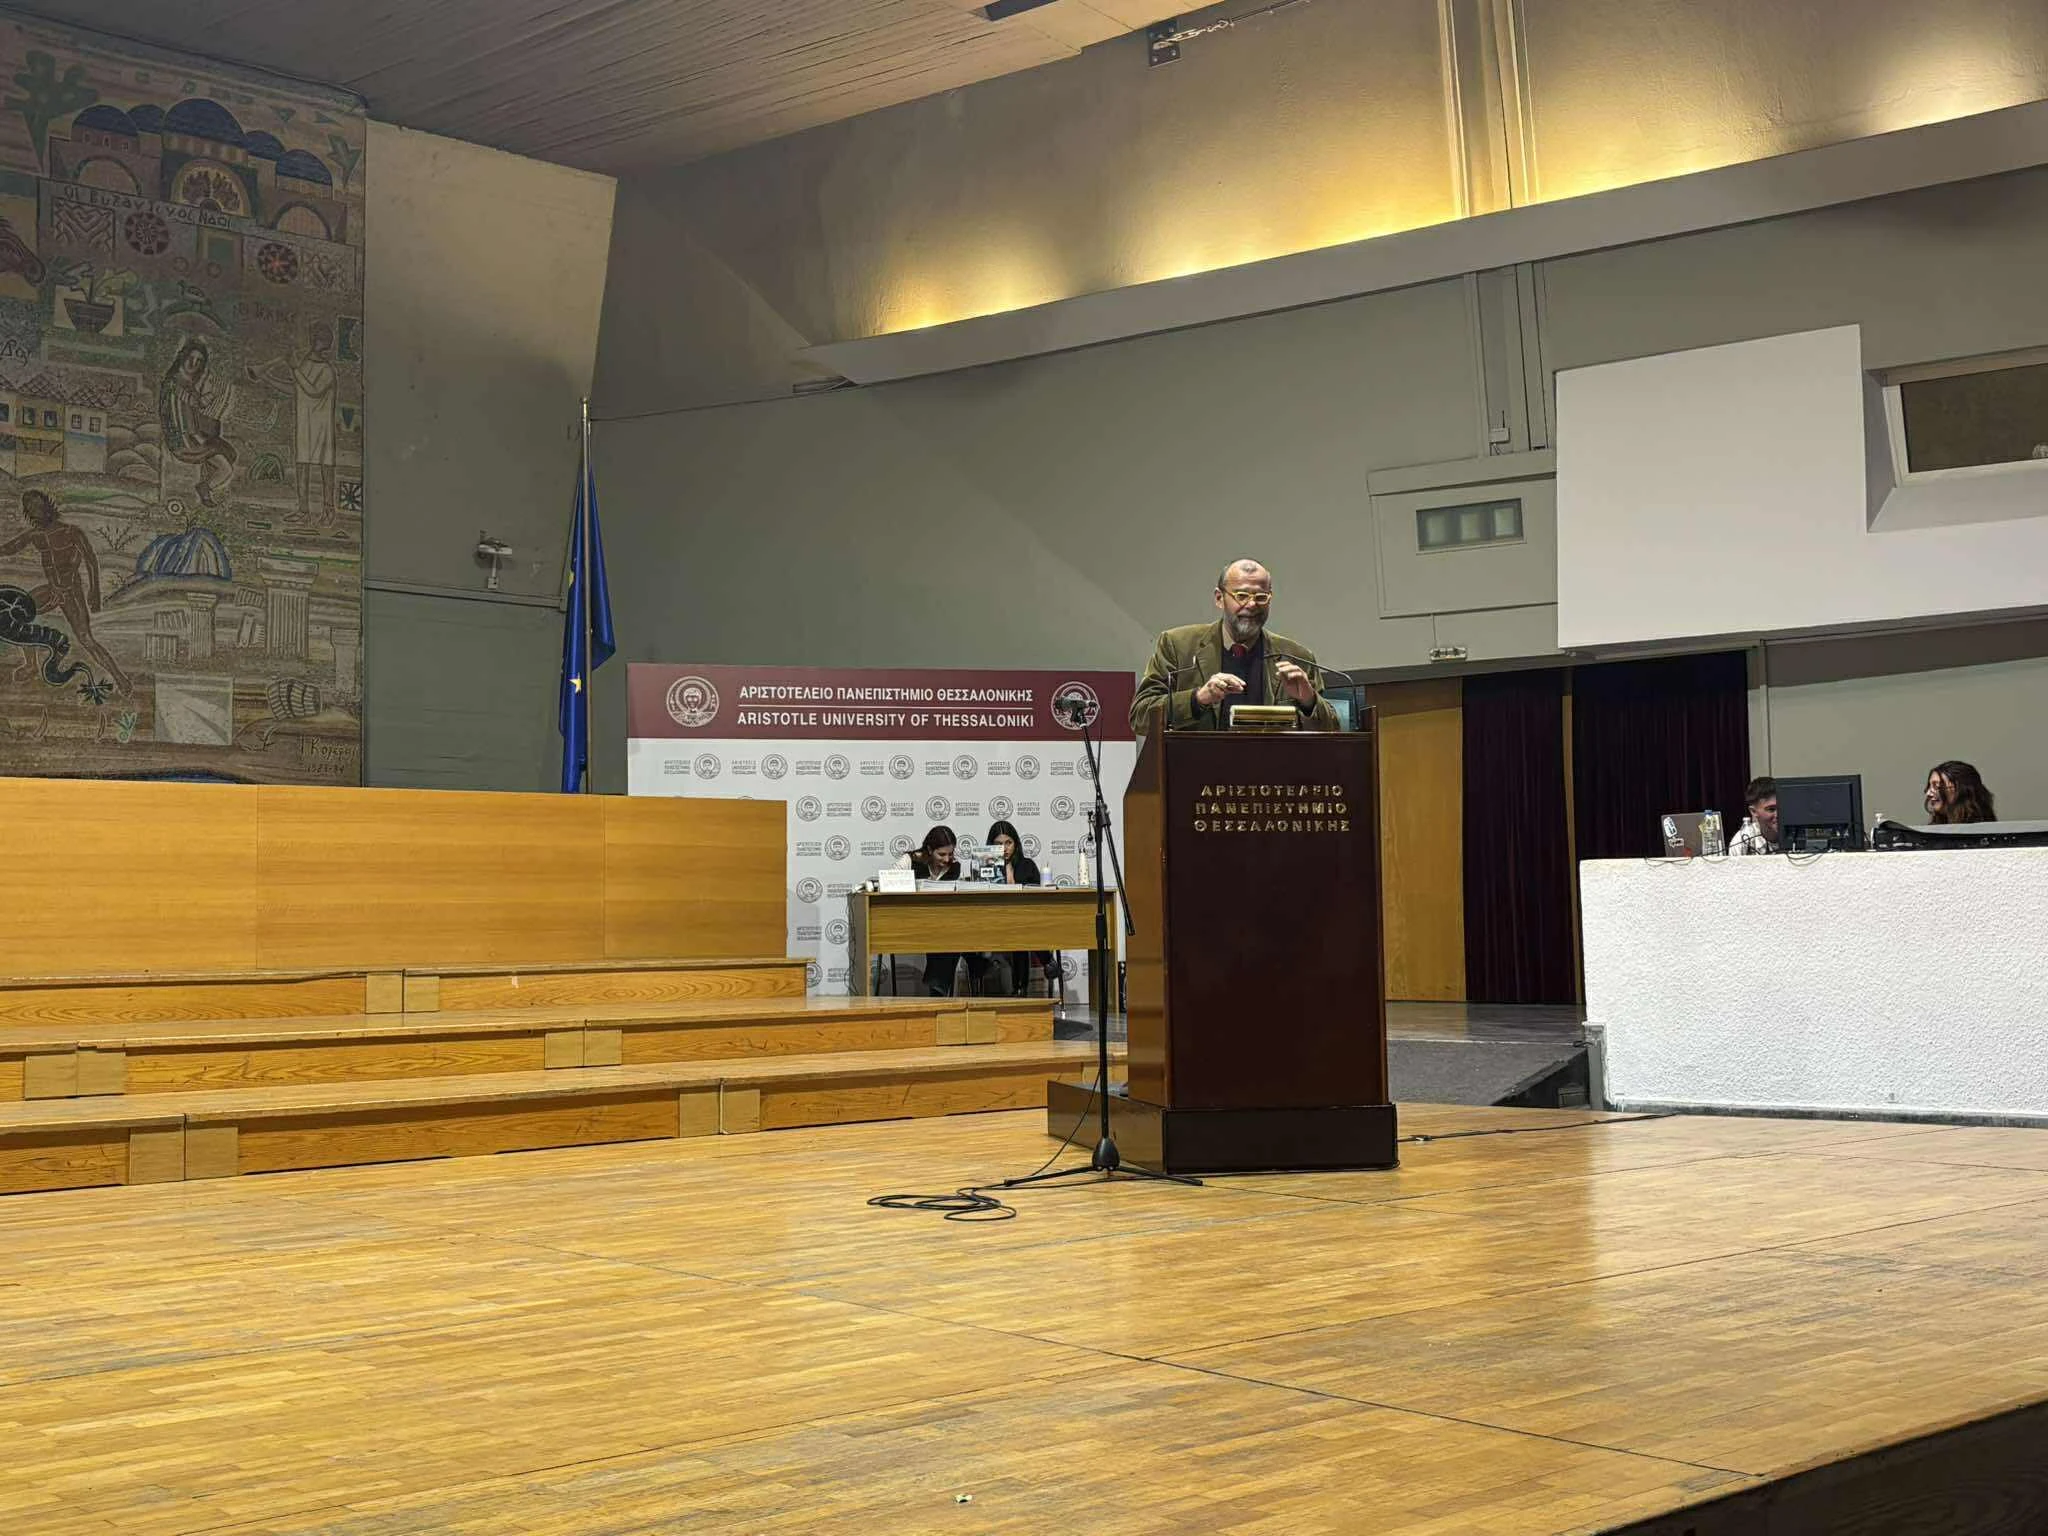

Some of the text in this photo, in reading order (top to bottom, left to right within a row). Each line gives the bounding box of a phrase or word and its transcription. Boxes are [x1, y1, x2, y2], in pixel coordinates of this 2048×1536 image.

[740, 686, 1033, 702] ΑΡΙΣΤΟΤΕΛΕΙΟ ΠΑΝΕΠΙΣΤΗΜΙΟ ΘΕΣΣΑΛΟΝΙΚΗΣ
[737, 712, 1034, 727] ARISTOTLE UNIVERSITY OF THESSALONIKI
[1201, 785, 1343, 797] ΑΡΙΣΤΟΤΕΛΕΙΟ
[1195, 802, 1347, 815] ΠΑΝΕΠΙΣΤΗΜΙΟ
[1193, 820, 1350, 832] ΘΕΣΣΑΛΟΝΙΚΗΣ
